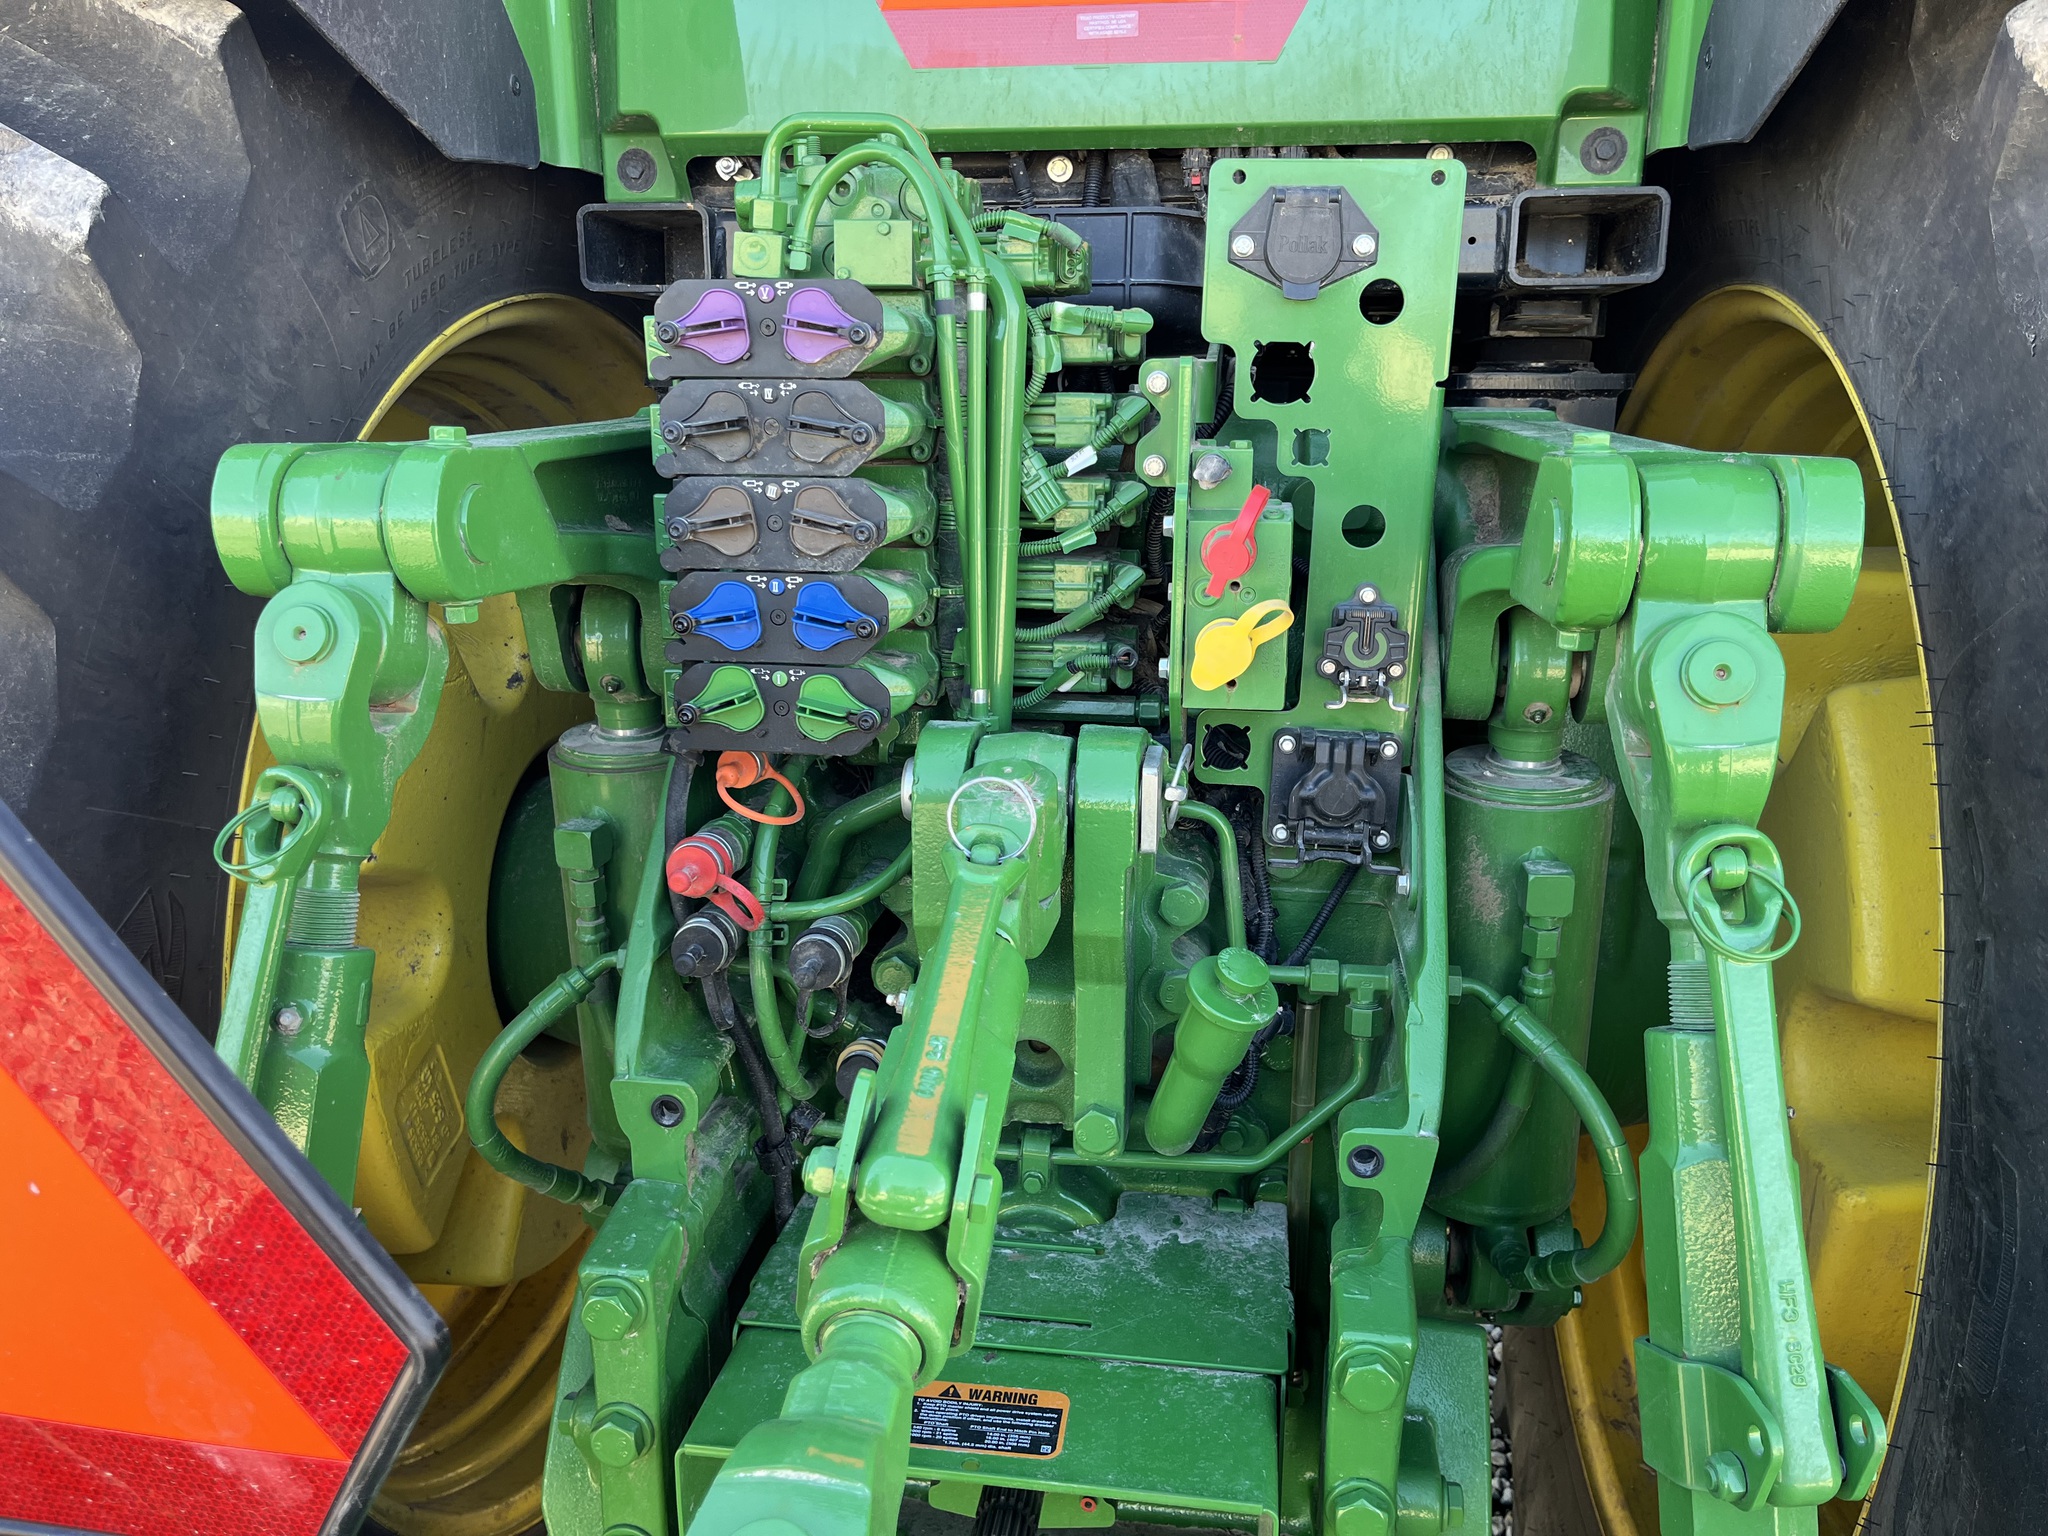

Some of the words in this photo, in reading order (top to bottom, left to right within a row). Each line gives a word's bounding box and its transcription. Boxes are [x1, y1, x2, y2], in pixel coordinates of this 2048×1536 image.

[1278, 235, 1328, 254] Pollak
[403, 226, 473, 288] TUBELESS
[760, 287, 769, 300] V
[358, 339, 382, 383] MAY
[388, 310, 404, 340] BE
[410, 274, 446, 312] USED
[453, 250, 483, 280] TUBE
[491, 239, 522, 258] TYPE
[764, 389, 773, 399] IV
[767, 486, 777, 497] III
[969, 1388, 1038, 1405] WARNING
